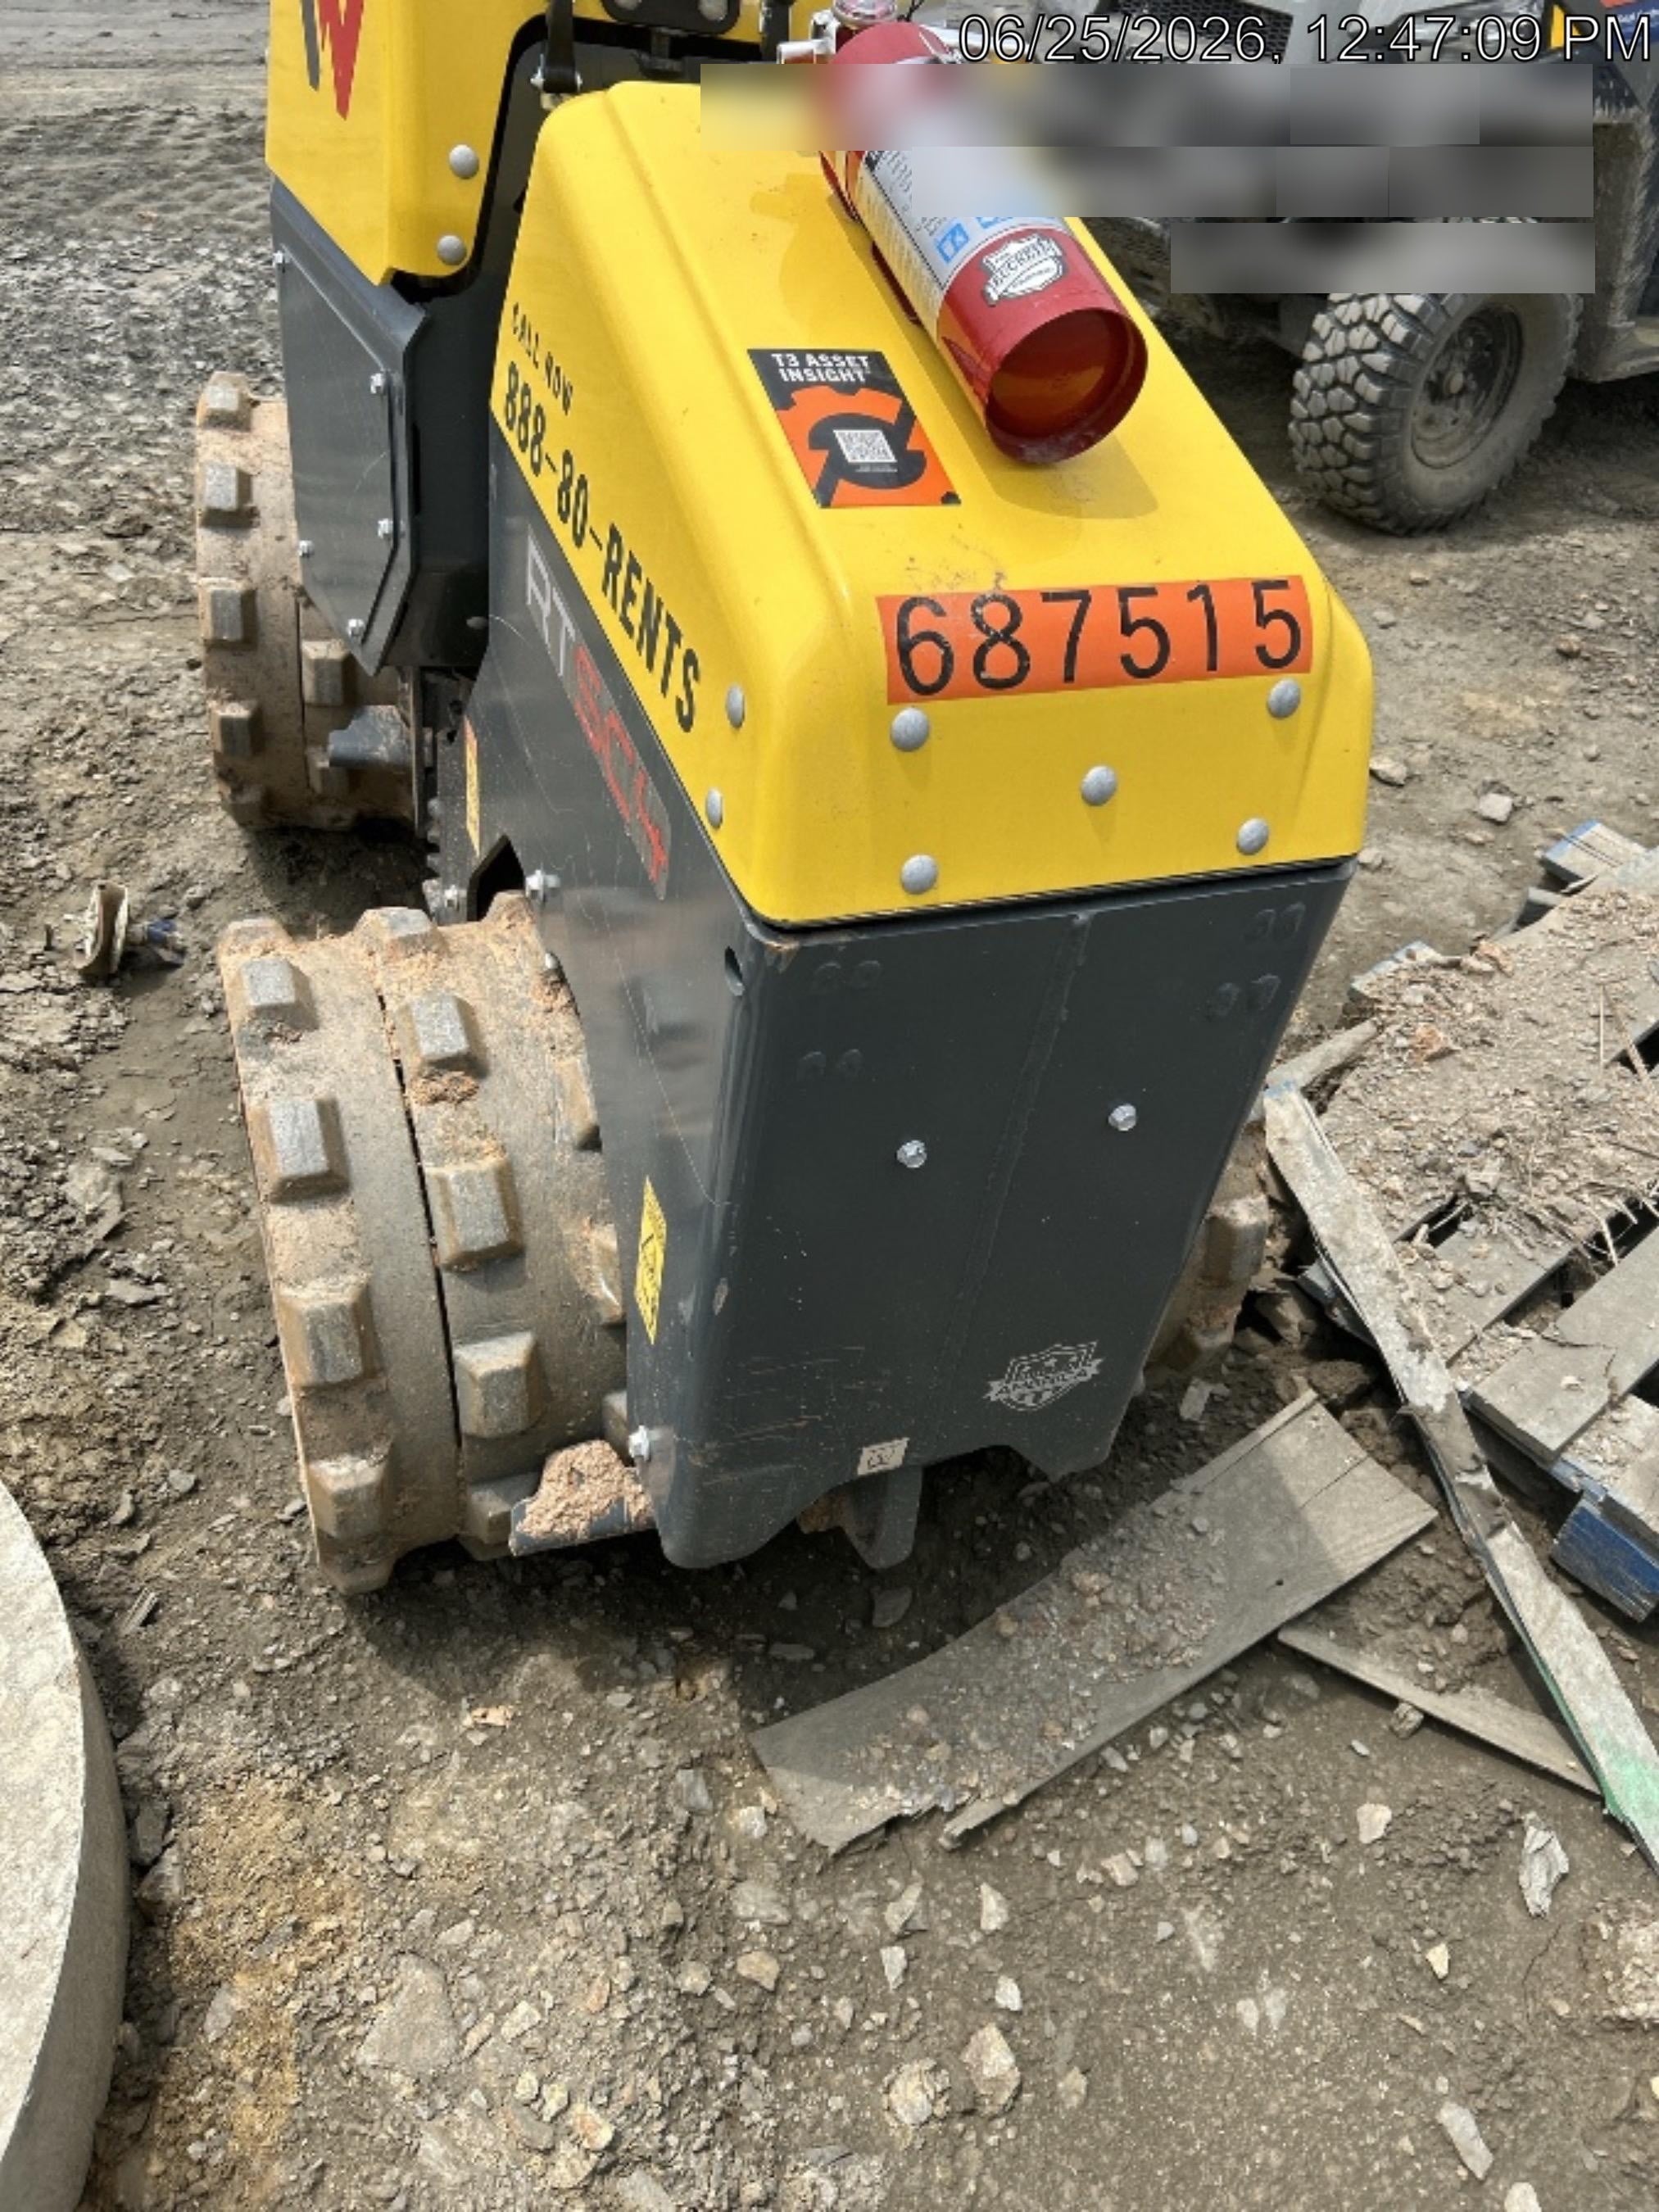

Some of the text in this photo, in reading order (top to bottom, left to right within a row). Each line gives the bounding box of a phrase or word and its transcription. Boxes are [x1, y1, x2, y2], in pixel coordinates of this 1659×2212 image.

[512, 301, 573, 416] CALL NOW
[771, 352, 869, 369] T3 ASSET
[504, 360, 700, 733] 888-80-RENTS
[896, 580, 1302, 696] 687515
